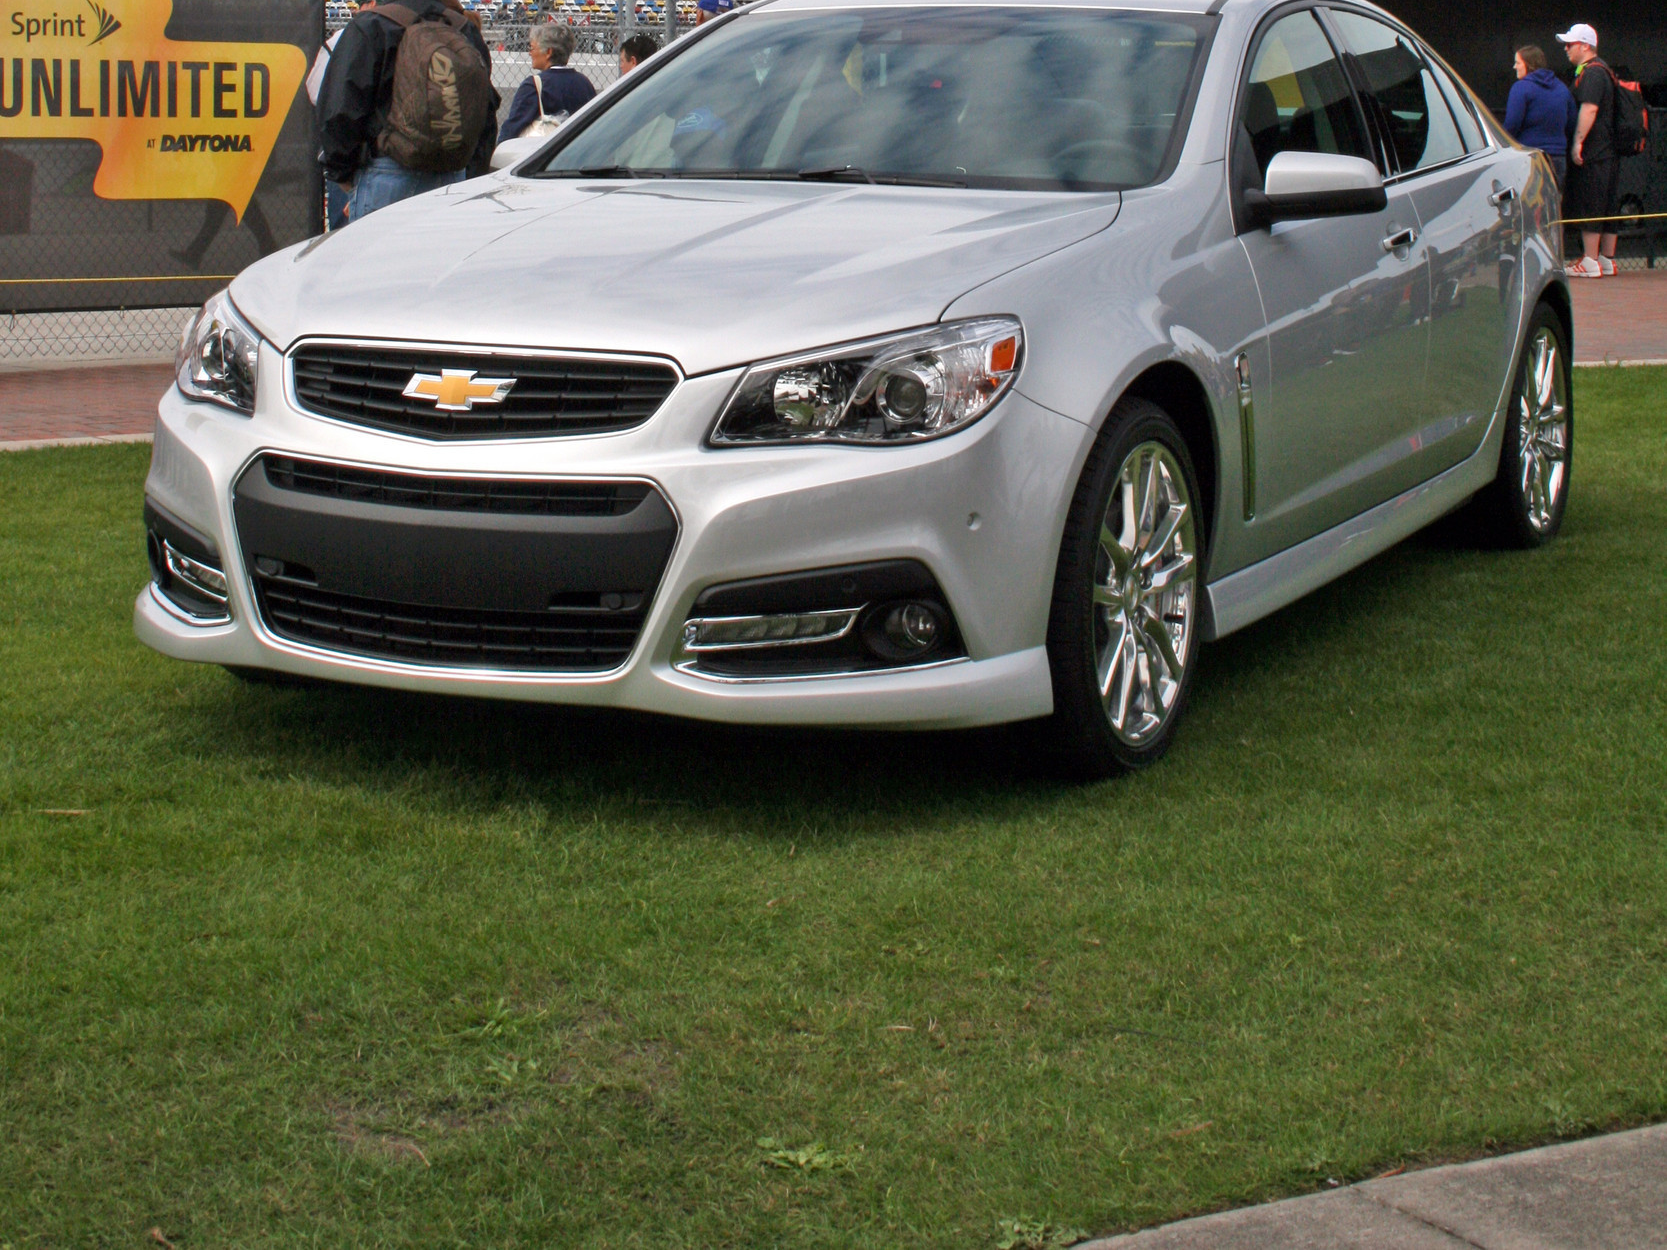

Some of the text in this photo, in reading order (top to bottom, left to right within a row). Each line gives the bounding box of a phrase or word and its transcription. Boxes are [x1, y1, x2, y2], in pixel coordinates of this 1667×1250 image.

[11, 11, 86, 43] Sprint
[0, 57, 271, 119] UNLIMITED
[146, 134, 252, 152] AT DAYTONA
